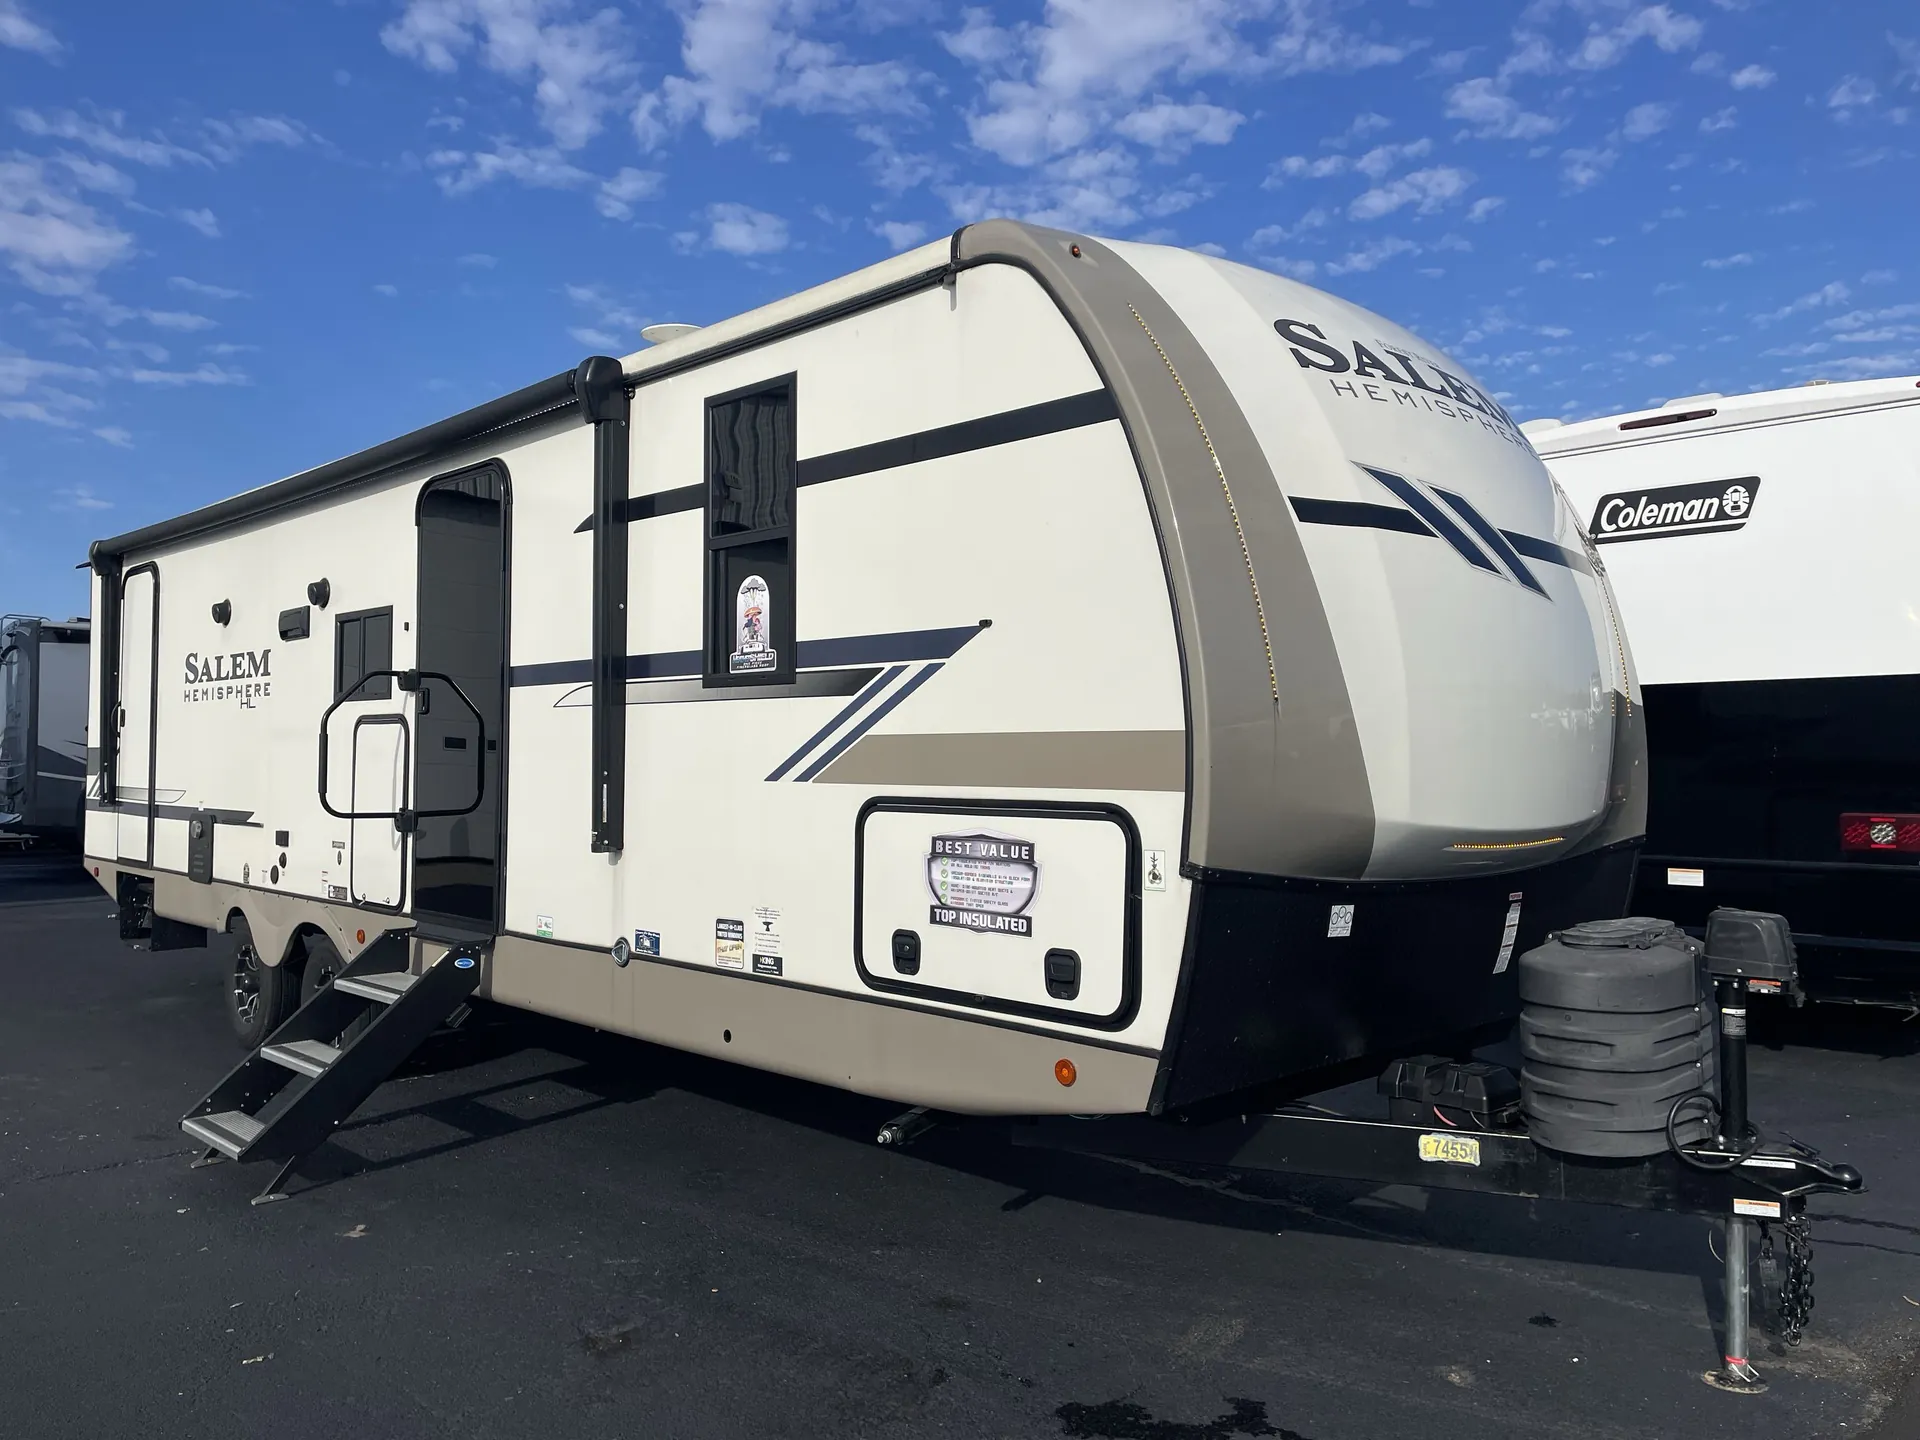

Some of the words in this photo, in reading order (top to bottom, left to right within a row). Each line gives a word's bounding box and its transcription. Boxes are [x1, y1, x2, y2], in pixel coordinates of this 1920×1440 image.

[1273, 318, 1532, 446] SALEM
[1329, 378, 1539, 461] HEMISPHERE
[1600, 496, 1719, 532] Coleman
[185, 649, 272, 685] SALEM
[184, 682, 271, 703] HEMISPHERE
[240, 698, 257, 709] HL
[935, 840, 972, 855] BEST
[980, 843, 1030, 860] VALUE
[934, 908, 956, 923] TOP
[959, 911, 1028, 933] INSULATED
